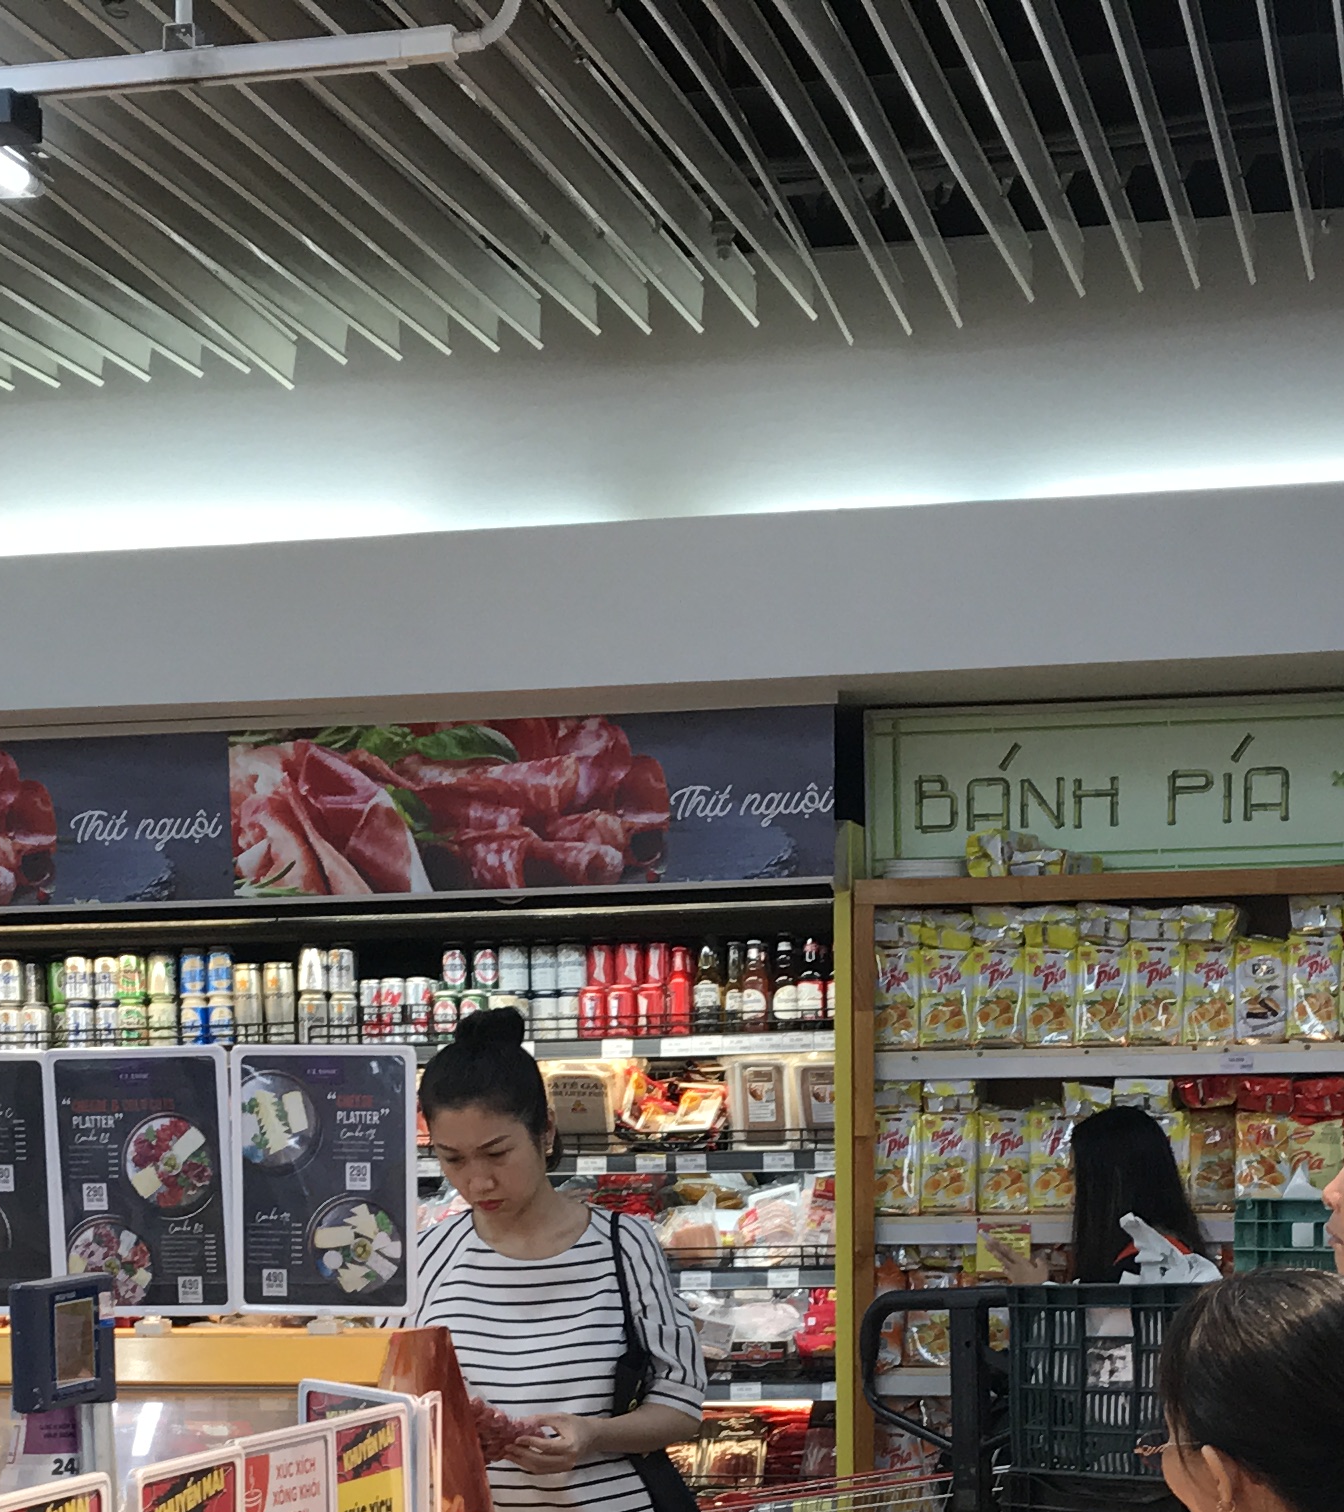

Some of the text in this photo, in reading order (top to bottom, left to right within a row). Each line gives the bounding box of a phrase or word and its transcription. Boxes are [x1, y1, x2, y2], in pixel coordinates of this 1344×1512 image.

[670, 782, 834, 820] Thịt nguội
[914, 732, 1291, 834] BÁNH PÍA
[70, 808, 223, 845] Thịt nguội
